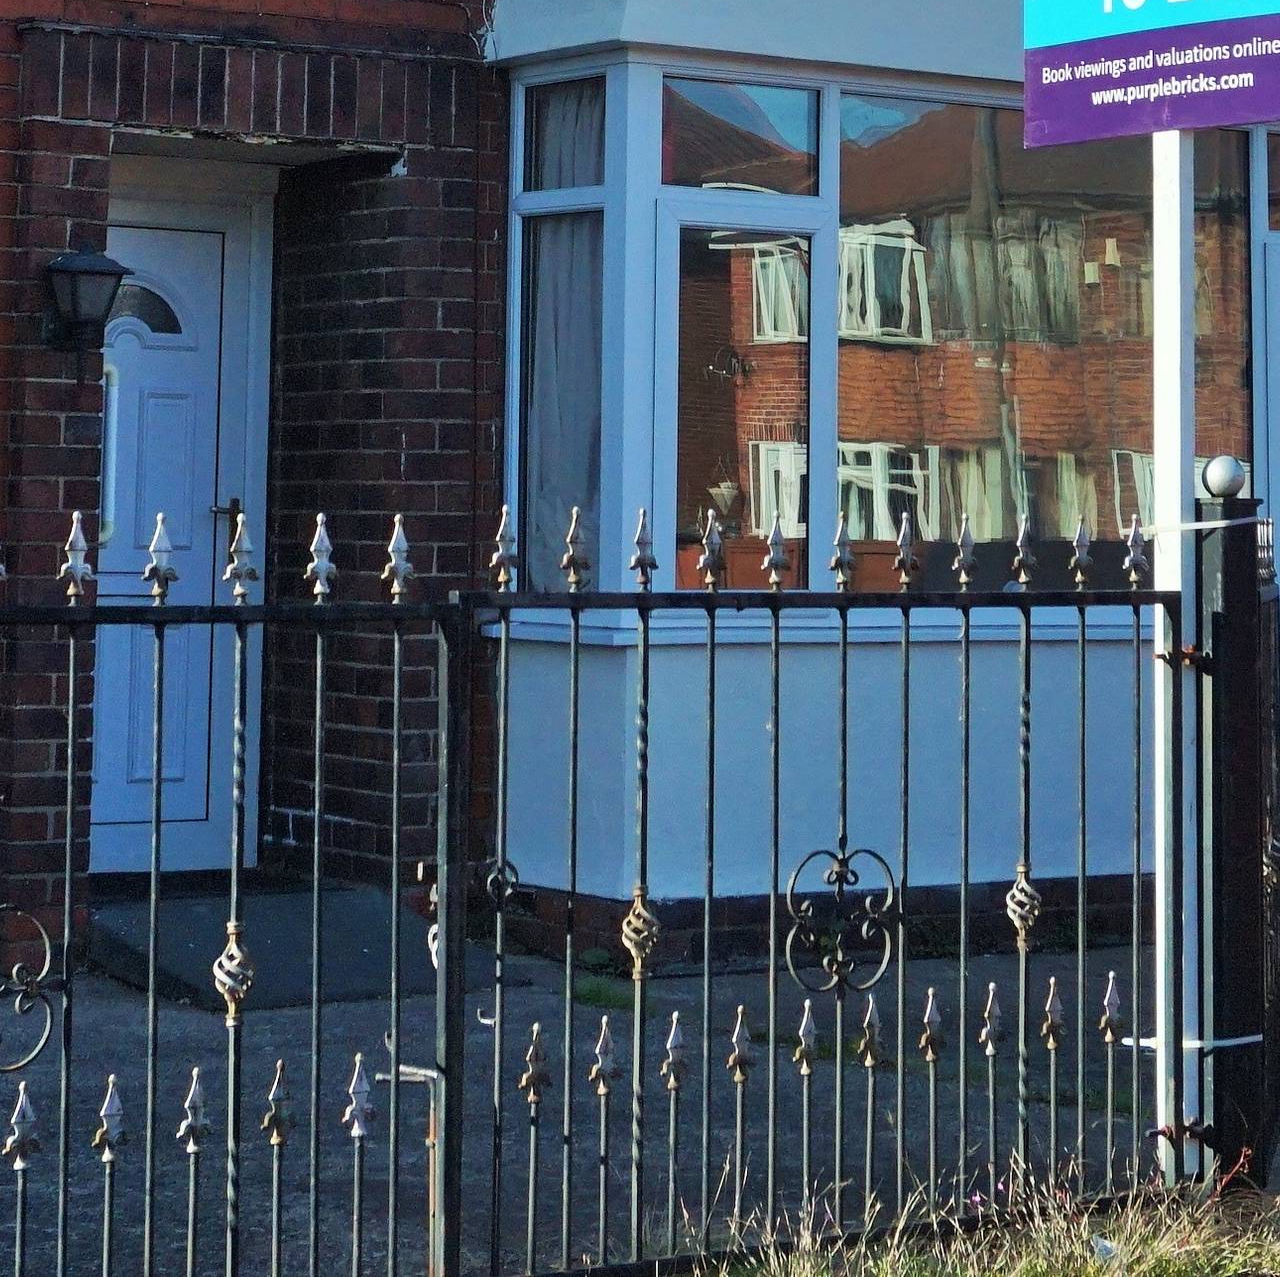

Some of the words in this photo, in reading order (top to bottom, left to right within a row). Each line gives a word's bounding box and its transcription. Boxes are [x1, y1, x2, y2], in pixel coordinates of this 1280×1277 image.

[1042, 63, 1072, 84] Book
[1074, 58, 1126, 78] viewings
[1128, 49, 1154, 72] and
[1155, 43, 1230, 68] valuations
[1091, 72, 1254, 105] www.purplebricks.com
